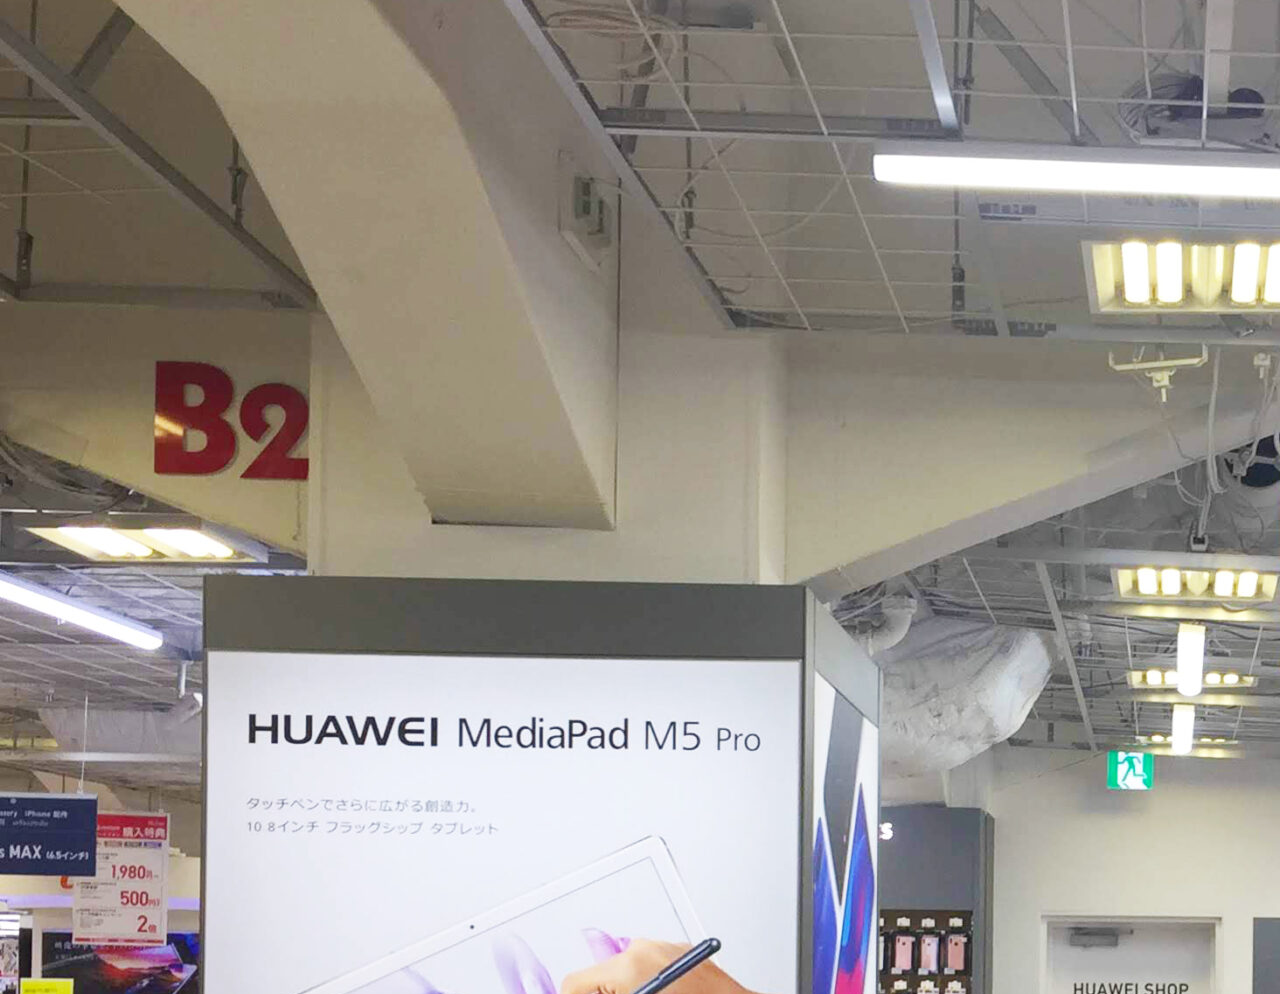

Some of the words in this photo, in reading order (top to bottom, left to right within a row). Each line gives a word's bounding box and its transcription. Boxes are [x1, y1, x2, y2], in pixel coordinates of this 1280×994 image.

[155, 361, 309, 480] B2
[249, 714, 439, 747] HUAWEI
[458, 717, 629, 750] MediaPad
[645, 721, 701, 751] M5
[717, 728, 762, 752] Pro
[246, 797, 477, 814] タッチペンでさらに広がる創造力。
[326, 821, 424, 834] フラッグシップ
[431, 822, 499, 835] タブレット
[9, 844, 42, 860] MAX
